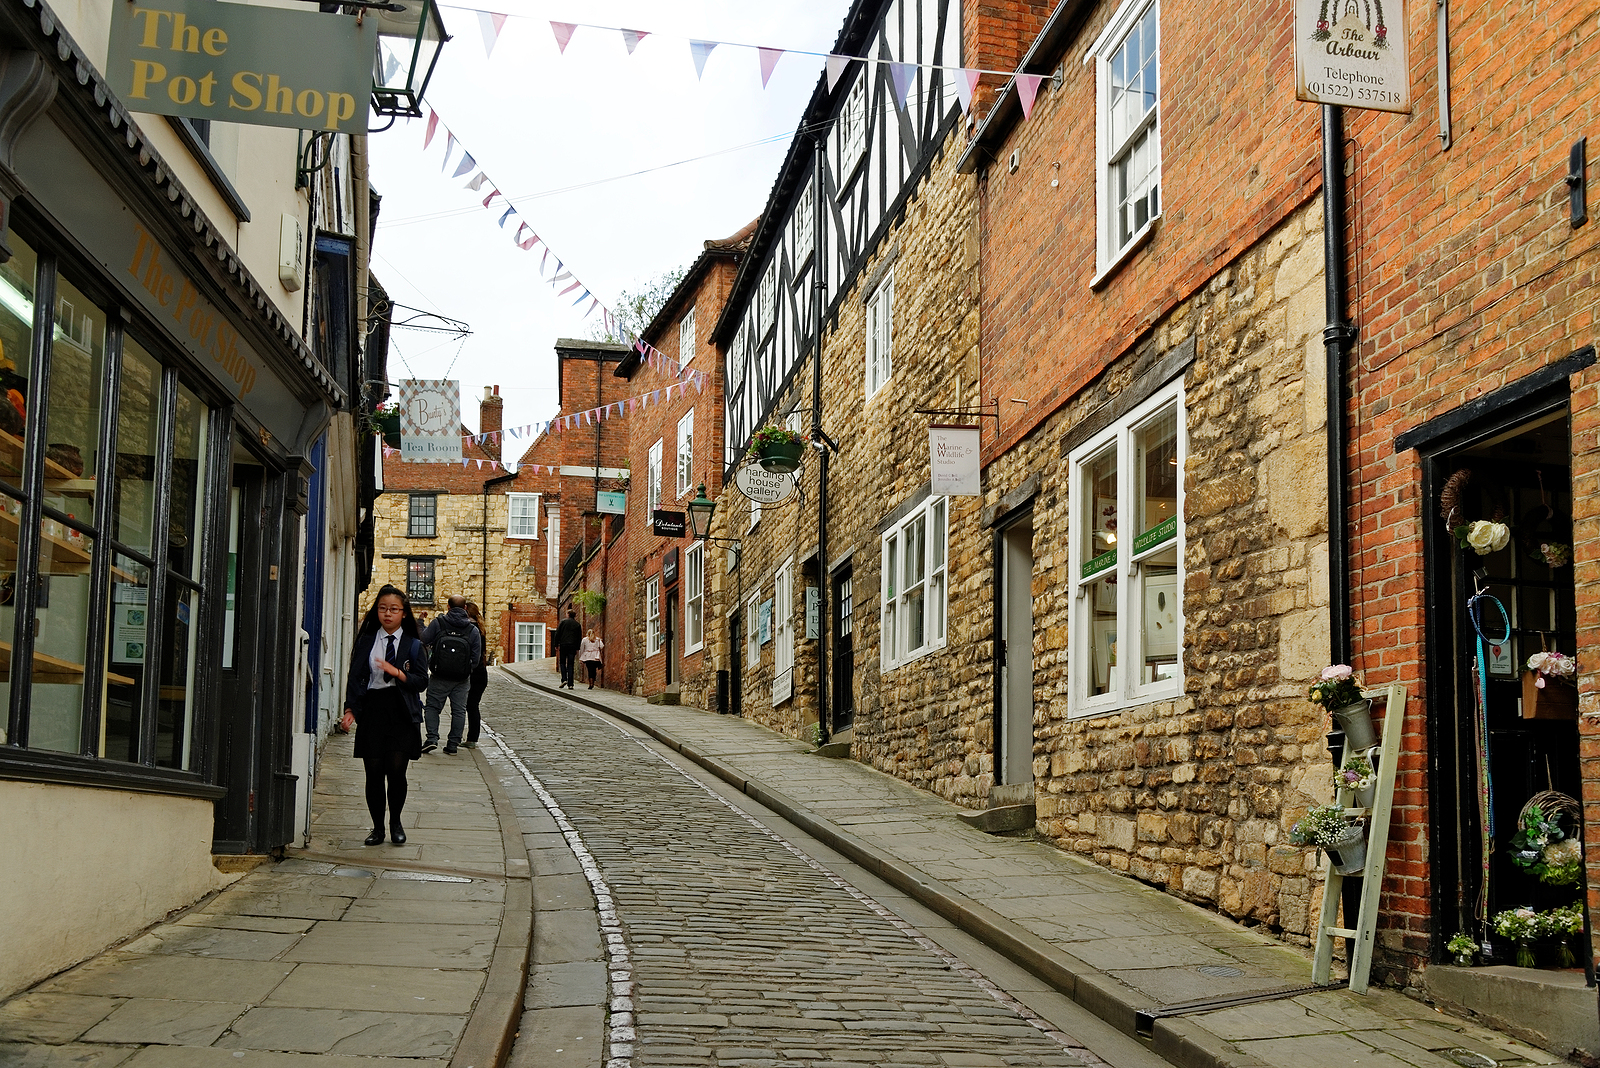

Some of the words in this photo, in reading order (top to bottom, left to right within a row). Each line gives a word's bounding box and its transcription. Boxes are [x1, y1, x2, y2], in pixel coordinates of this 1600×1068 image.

[133, 8, 229, 57] The
[1341, 27, 1365, 42] The
[1326, 40, 1381, 61] Arbour
[1323, 66, 1385, 86] Telephone
[127, 59, 218, 107] Pot
[228, 71, 356, 131] Shop
[1307, 81, 1354, 101] (01522)
[1357, 87, 1401, 104] 537518
[127, 223, 175, 307] The
[172, 276, 215, 349] Pot
[209, 319, 258, 401] Shop
[415, 398, 447, 426] Bunty's
[405, 442, 423, 452] Tea
[427, 442, 459, 452] Room
[937, 442, 963, 451] Marine
[937, 449, 964, 458] Wildlife
[745, 466, 785, 483] harding
[749, 476, 781, 489] house
[746, 486, 781, 500] gallery
[1135, 531, 1157, 550] WILDLIFE
[1158, 520, 1176, 537] STUDIO
[1083, 564, 1092, 575] THE
[1093, 555, 1111, 571] MARINE
[810, 589, 819, 637] OPEN
